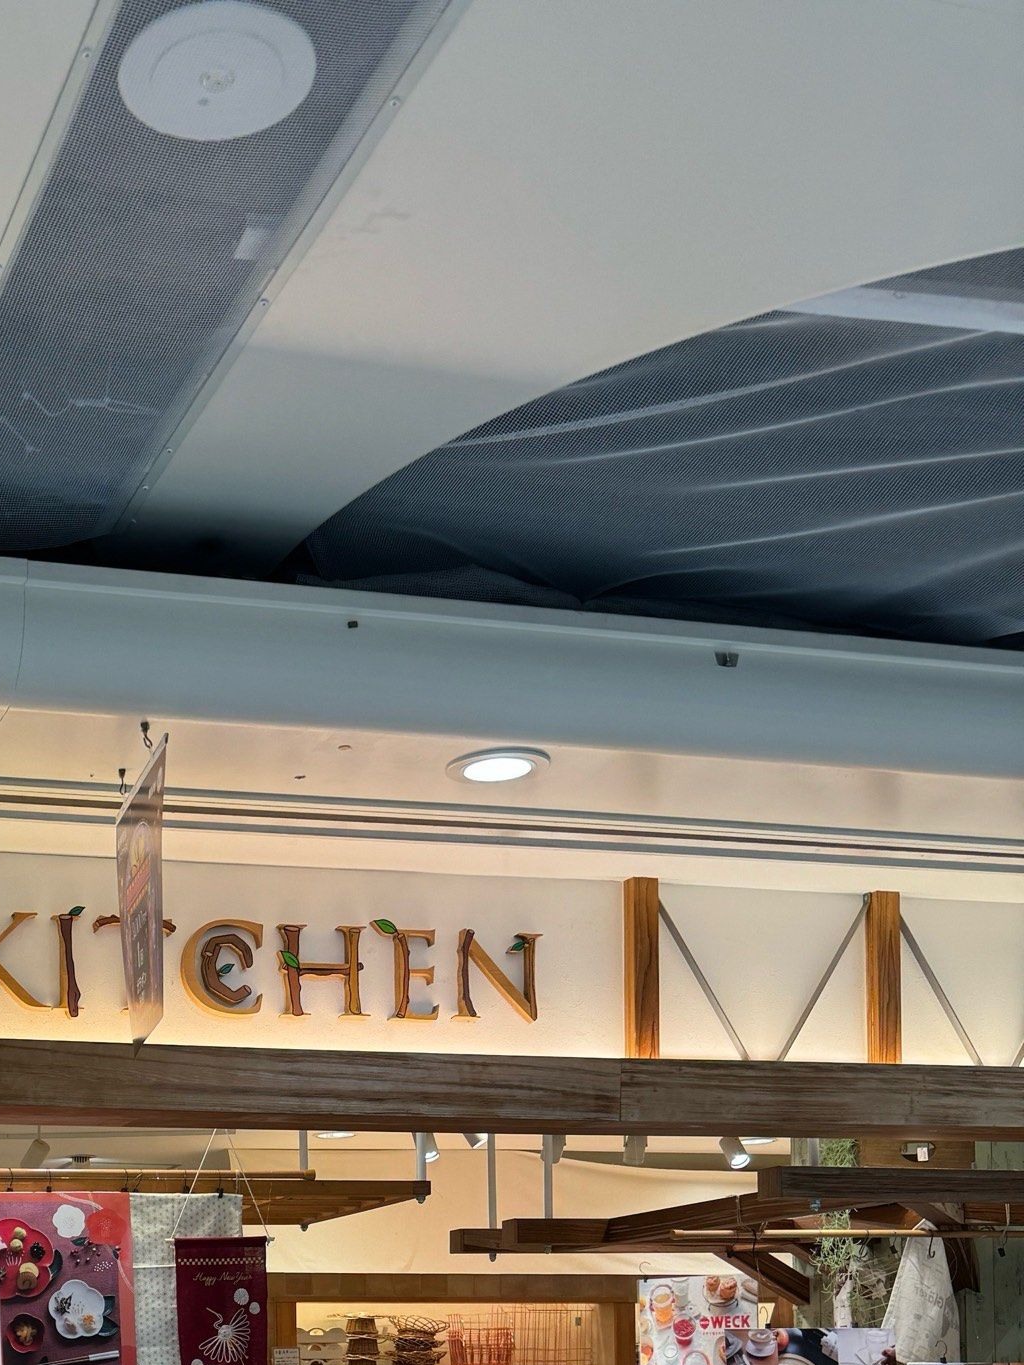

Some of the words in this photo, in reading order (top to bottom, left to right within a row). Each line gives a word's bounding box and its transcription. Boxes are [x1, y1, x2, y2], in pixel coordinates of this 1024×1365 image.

[192, 1271, 218, 1286] Happy
[218, 1271, 235, 1281] New
[710, 1314, 751, 1329] WECK
